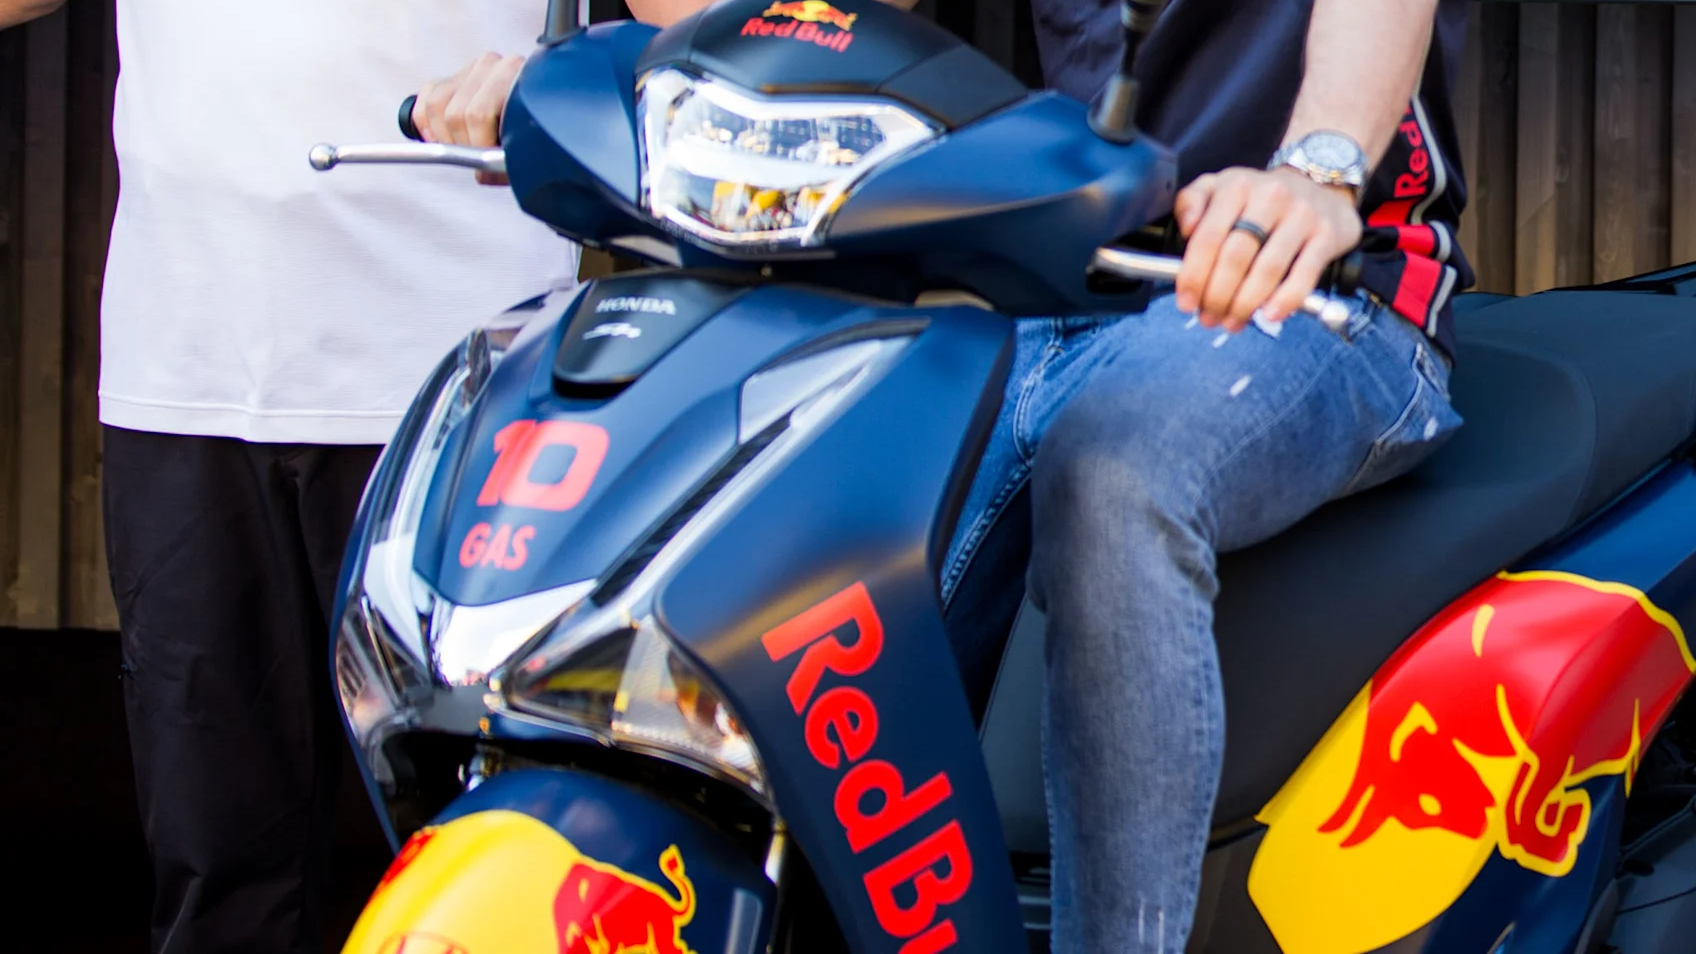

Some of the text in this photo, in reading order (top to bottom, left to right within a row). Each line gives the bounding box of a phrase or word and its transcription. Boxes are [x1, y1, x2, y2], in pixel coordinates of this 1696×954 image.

[595, 296, 677, 316] HONDA
[476, 419, 610, 512] 10
[458, 521, 537, 572] GAS
